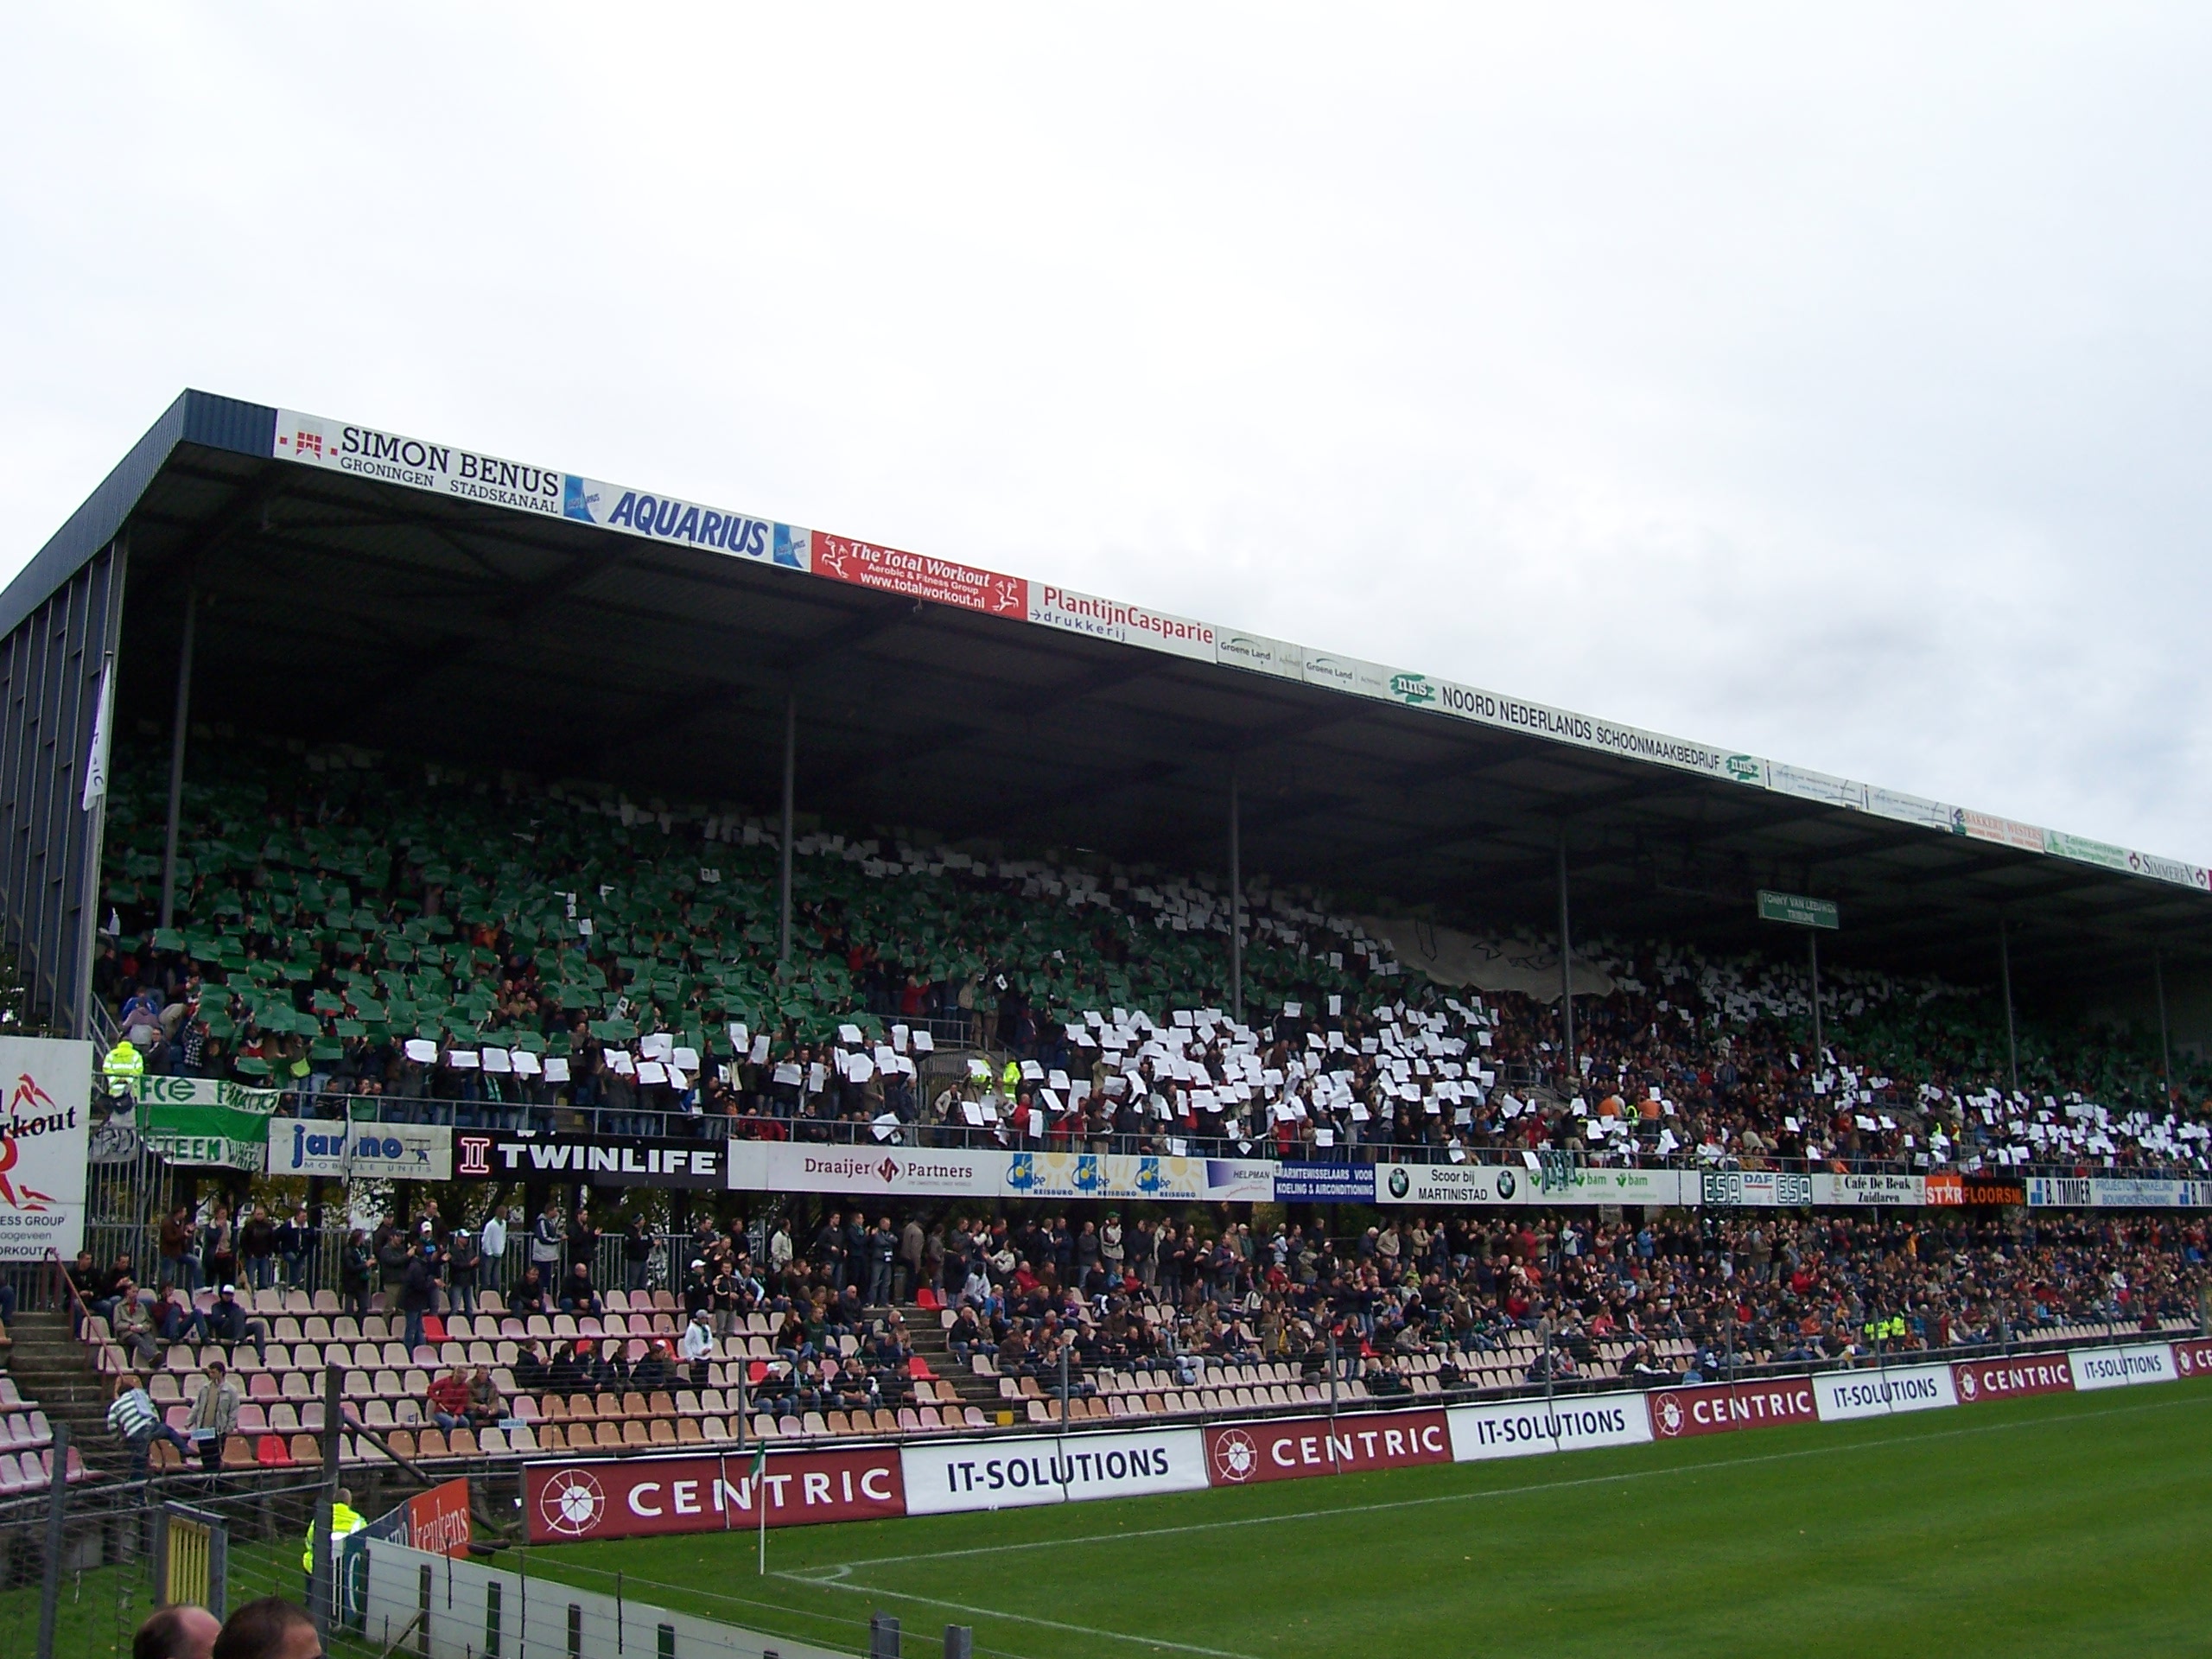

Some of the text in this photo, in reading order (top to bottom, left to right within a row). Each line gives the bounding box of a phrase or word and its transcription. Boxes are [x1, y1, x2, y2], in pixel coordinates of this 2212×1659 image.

[342, 427, 558, 496] SIMON BENUS
[340, 456, 558, 514] GRONINGEN STADSKANAAL
[608, 492, 769, 556] AQUARIUS
[850, 542, 991, 588] The Total Workout
[868, 563, 979, 596] Aerobic & Fitness Group
[860, 572, 985, 609] www.totalworkout.nl
[1044, 587, 1214, 644] PlantijnCasparie
[1044, 610, 1125, 641] drukkerij
[1221, 642, 1271, 660] Groene Land
[1306, 662, 1353, 680] Groene Land
[1442, 685, 1720, 771] NOORD NEDERLANDS SCHOONMAAKBEDRIJF
[499, 1142, 717, 1175] TWINLIFE
[804, 1158, 973, 1179] Draaijer Partners
[1233, 1170, 1270, 1179] HELPMAN
[1276, 1183, 1307, 1194] KOELING
[1354, 1169, 1374, 1181] VOOR
[1431, 1169, 1475, 1185] Scoor bij
[1587, 1173, 1607, 1185] bam
[1629, 1173, 1648, 1185] bam
[1744, 1174, 1773, 1184] DAF
[1845, 1176, 1867, 1190] Café
[1870, 1177, 1884, 1190] De
[1418, 1187, 1488, 1201] MARTINISTAD
[1858, 1192, 1900, 1203] Zuidlaren
[25, 1216, 65, 1226] GROUP
[1983, 1363, 2069, 1392] CENTRIC
[2083, 1354, 2163, 1380] IT-SOLUTIONS
[1693, 1389, 1812, 1425] CENTRIC
[1833, 1377, 1938, 1409] IT-SOLUTIONS
[1477, 1408, 1625, 1445] IT-SOLUTIONS
[1271, 1425, 1444, 1467] CENTRIC
[947, 1446, 1169, 1494] IT-SOLUTIONS
[627, 1466, 892, 1518] CENTRIC
